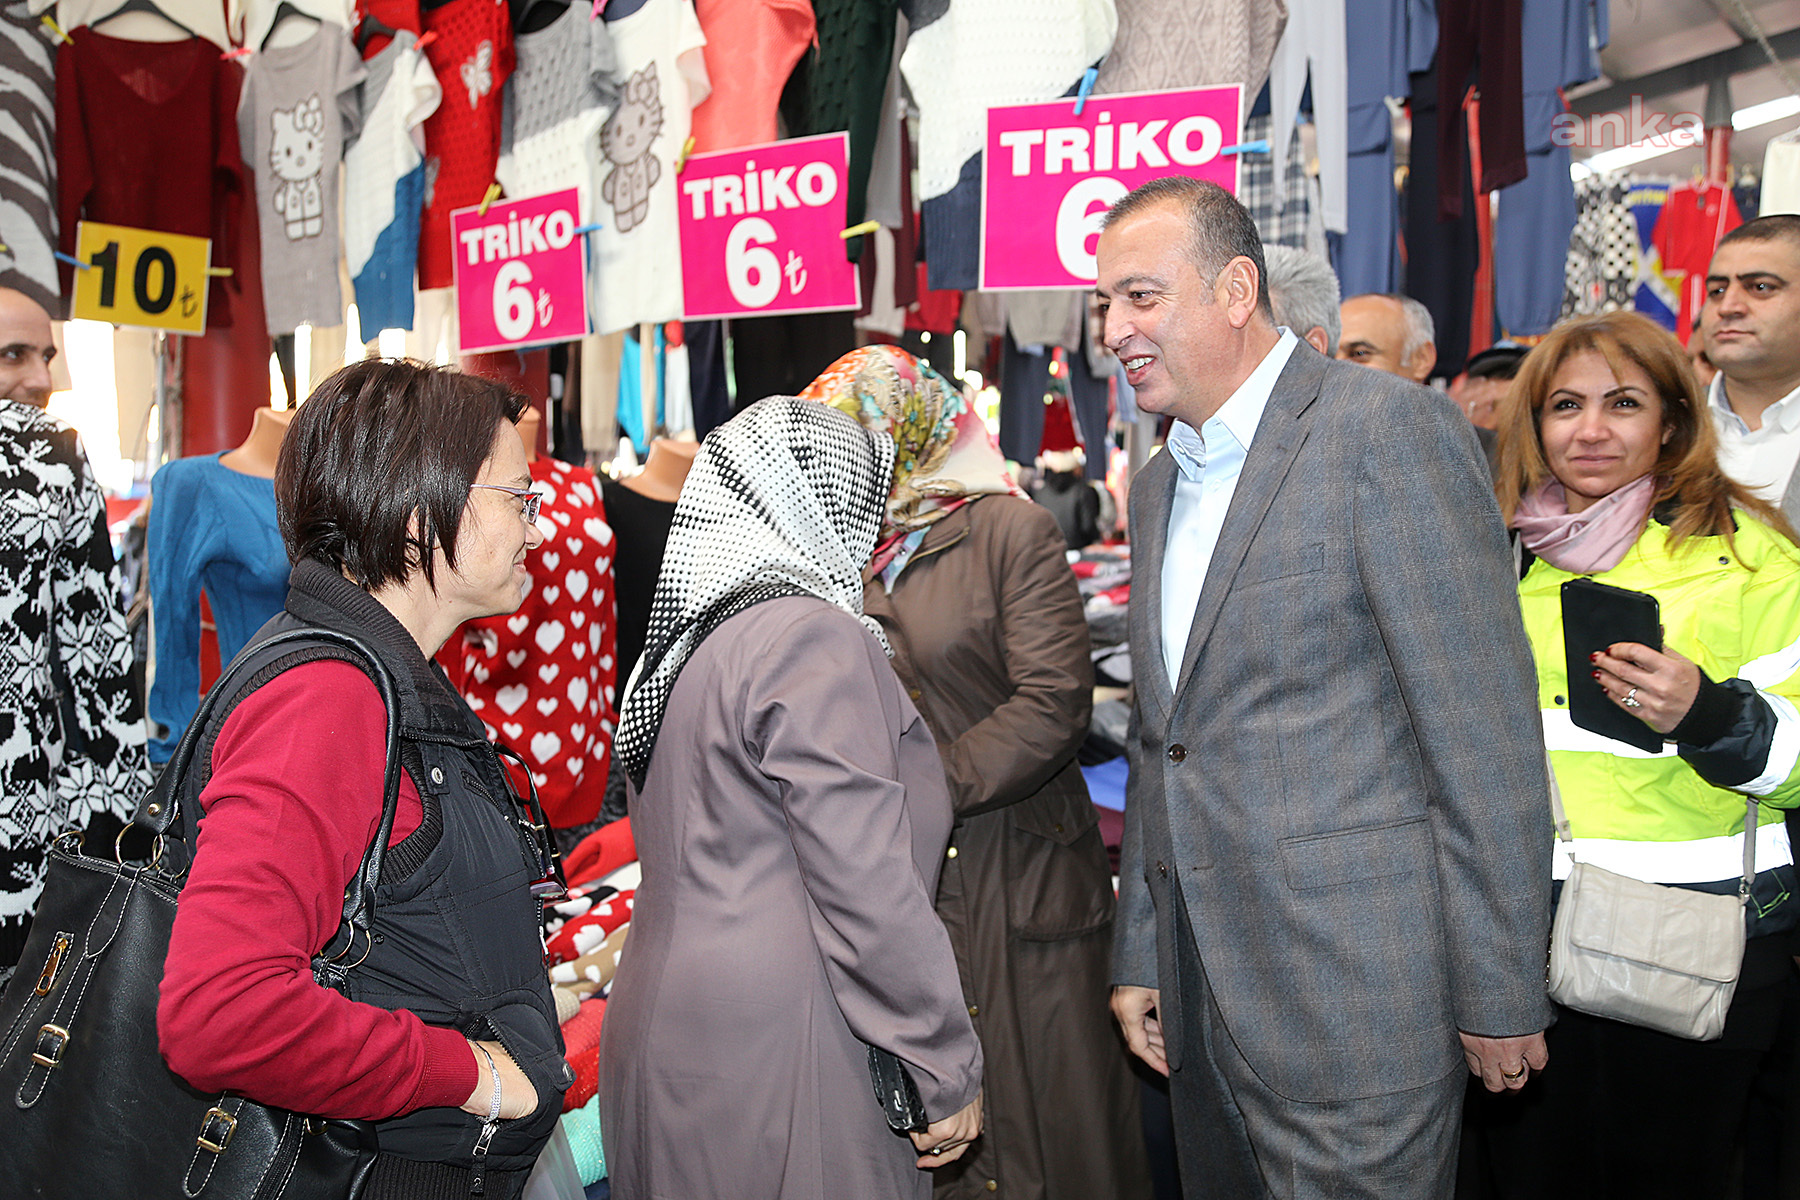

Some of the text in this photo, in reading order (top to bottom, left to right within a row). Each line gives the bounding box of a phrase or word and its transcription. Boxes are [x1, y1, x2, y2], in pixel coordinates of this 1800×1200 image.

[1000, 111, 1223, 176] TRİKO
[683, 160, 838, 220] TRİKO
[460, 210, 575, 265] TRİKO
